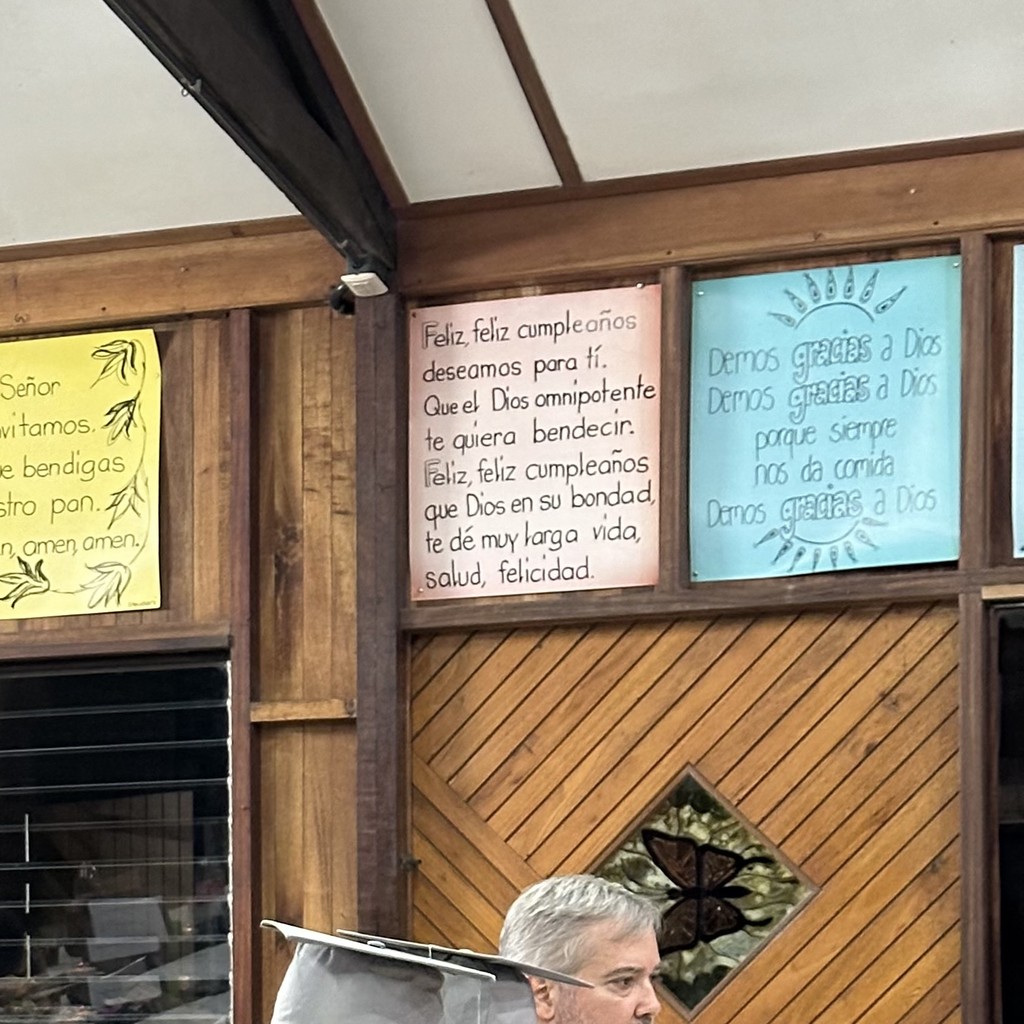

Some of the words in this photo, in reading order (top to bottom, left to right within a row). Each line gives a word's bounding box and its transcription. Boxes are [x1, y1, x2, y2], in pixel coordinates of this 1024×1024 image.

[421, 321, 470, 349] Feliz,
[474, 316, 510, 343] feliz
[518, 309, 637, 344] cumpleaños
[422, 361, 522, 382] deseamos
[534, 357, 577, 382] para
[709, 346, 780, 377] Demos
[792, 329, 872, 383] gracias
[881, 334, 893, 361] a
[904, 327, 941, 358] Dios
[0, 374, 60, 400] Señor
[424, 394, 458, 416] Que
[462, 390, 480, 413] el
[492, 386, 529, 412] Dios
[535, 374, 656, 413] omnipotente
[708, 386, 775, 414] Demos
[789, 371, 870, 423] gracias
[877, 374, 888, 399] a
[901, 367, 938, 397] Dios
[425, 428, 444, 451] te
[453, 421, 516, 455] quiera
[533, 408, 634, 444] bendecir.
[756, 424, 816, 461] porque
[830, 415, 897, 449] siempre
[23, 450, 125, 482] bendigas
[424, 458, 473, 488] Feliz,
[478, 456, 516, 482] feliz
[525, 449, 649, 485] cumpleaños
[754, 464, 788, 488] nos
[801, 455, 823, 482] da
[834, 451, 895, 480] comida
[51, 495, 100, 524] pan.
[425, 503, 458, 530] que
[466, 492, 506, 518] Dios
[511, 497, 533, 514] en
[539, 493, 561, 511] su
[571, 480, 656, 508] bondad,
[707, 498, 766, 528] Demos
[781, 484, 863, 540] gracias
[874, 489, 886, 515] a
[896, 484, 936, 513] Dios
[22, 538, 77, 556] amen,
[82, 532, 140, 551] amen.
[426, 531, 444, 553] te
[450, 525, 475, 551] dé
[482, 532, 517, 553] muy
[525, 520, 578, 550] larga
[593, 514, 641, 544] vida,
[426, 559, 487, 589] salud,
[499, 554, 595, 584] felicidad.
